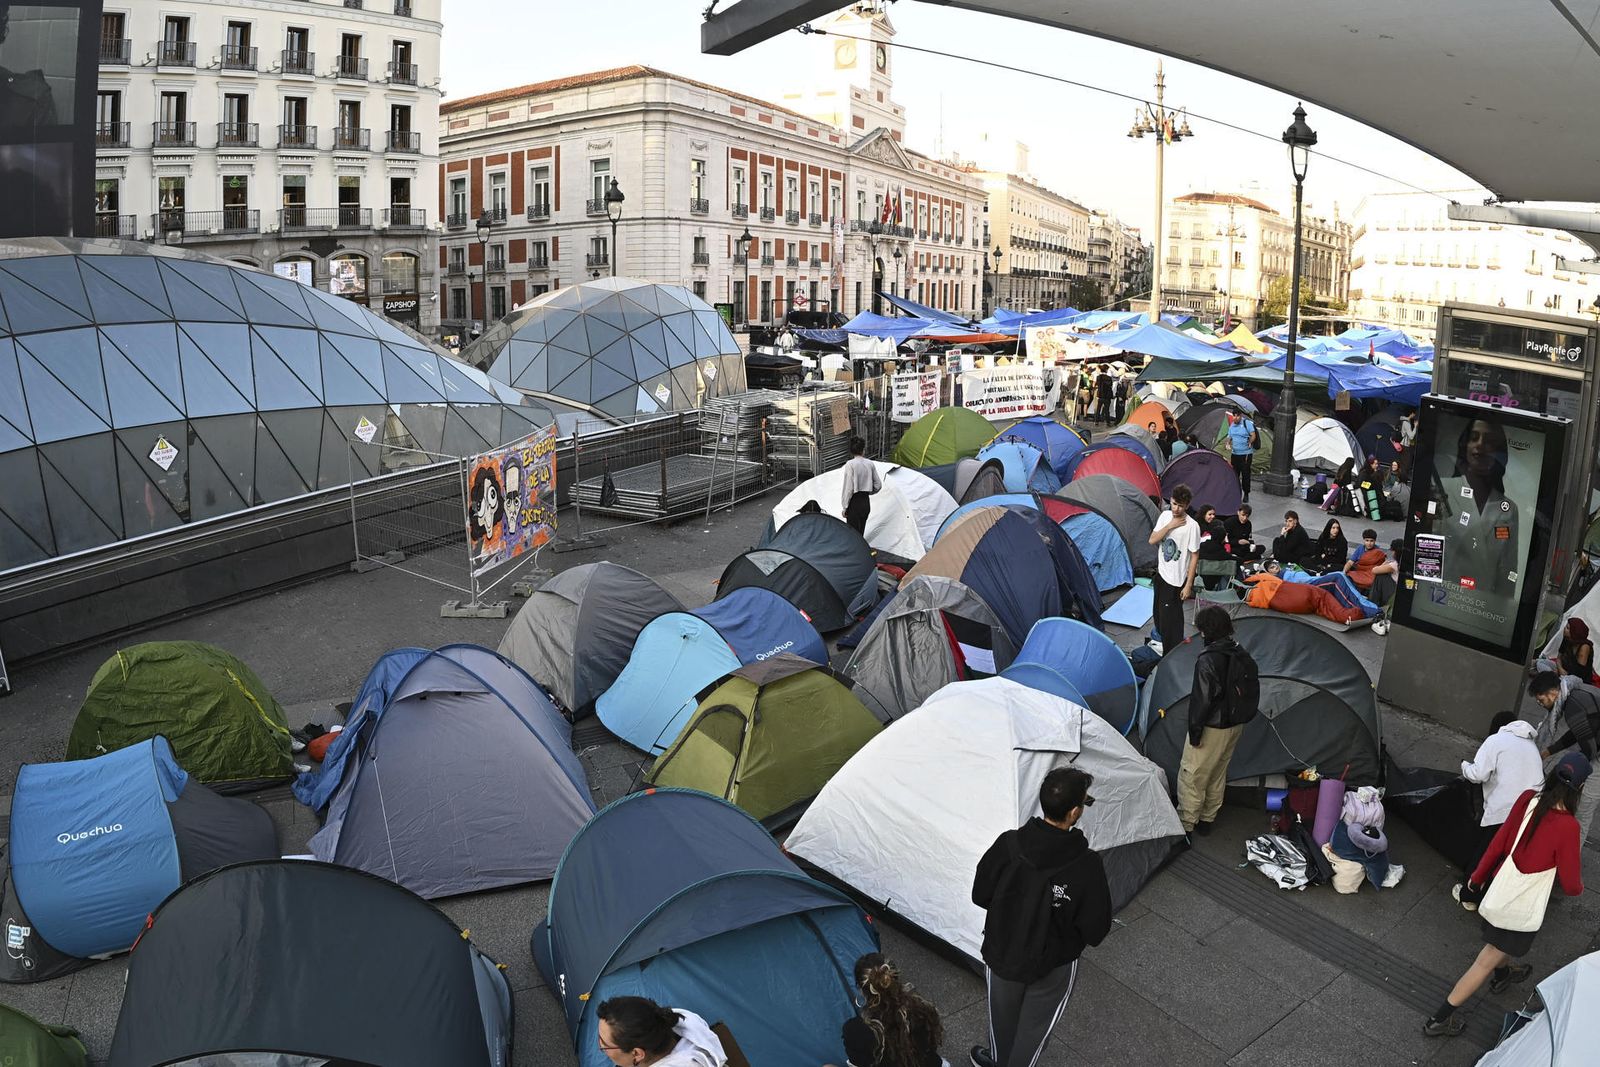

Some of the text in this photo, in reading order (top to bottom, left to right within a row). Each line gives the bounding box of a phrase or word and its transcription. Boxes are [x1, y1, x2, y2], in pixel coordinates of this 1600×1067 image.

[385, 300, 416, 309] ZAPSHOP
[1526, 340, 1566, 356] PlayRenfe
[1468, 390, 1520, 407] renfe
[988, 407, 996, 415] LA
[997, 405, 1016, 414] HUELGA
[522, 448, 534, 467] EL
[528, 469, 539, 489] DE
[1430, 586, 1447, 605] 12
[1476, 599, 1487, 608] DE
[755, 641, 793, 660] Quechua
[57, 823, 122, 844] Quechua
